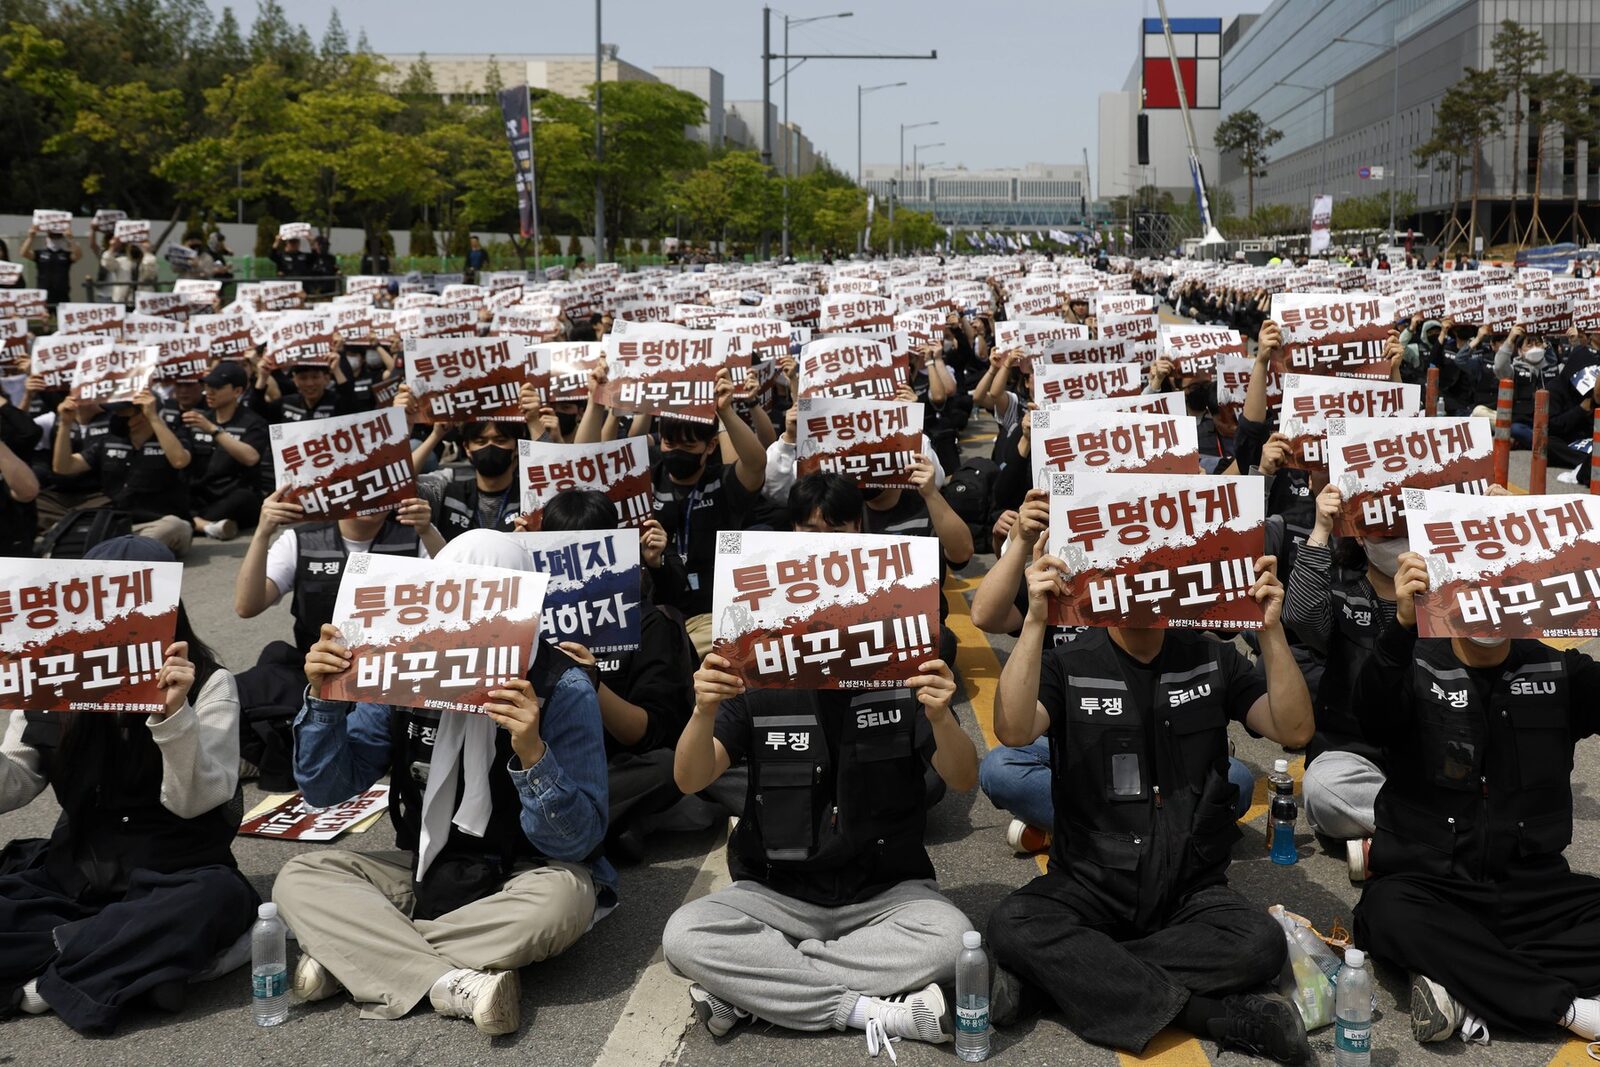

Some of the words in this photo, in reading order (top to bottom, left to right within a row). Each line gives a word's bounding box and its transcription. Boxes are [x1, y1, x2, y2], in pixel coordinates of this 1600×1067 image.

[775, 297, 821, 315] 투명하게
[828, 300, 886, 319] 투명하게
[903, 289, 946, 307] 투명하게
[1101, 298, 1147, 315] 투명하게
[1522, 301, 1568, 317] 투명하게
[64, 306, 117, 325] 투명하게
[195, 317, 244, 337] 투명하게
[424, 312, 471, 329] 투명하게
[1103, 317, 1153, 339] 투명하게
[1282, 299, 1380, 333] 투명하게
[1526, 319, 1571, 334] 바꾸고!!!
[617, 337, 713, 367] 투명하게
[1024, 327, 1081, 348] 투명하게
[1170, 331, 1232, 351] 투명하게
[414, 340, 511, 382] 투명하게
[805, 345, 882, 378] 투명하게
[431, 381, 520, 417] 바꾸고!!!
[621, 381, 714, 407] 바꾸고!!!
[1043, 366, 1129, 403] 투명하게
[1291, 387, 1404, 424] 투명하게
[807, 406, 908, 442] 투명하게
[281, 413, 392, 475] 투명하게
[1044, 420, 1179, 471] 투명하게
[1342, 422, 1474, 478] 투명하게
[527, 443, 636, 496] 투명하게
[299, 459, 412, 516] 바꾸고!!!
[1066, 482, 1240, 551] 투명하게
[1424, 499, 1594, 563] 투명하게
[308, 562, 339, 574] 투쟁
[732, 541, 913, 611] 투명하게
[1088, 556, 1257, 618] 바꾸고!!!
[350, 576, 521, 629] 투명하게
[754, 614, 932, 680] 바꾸고!!!
[356, 646, 520, 696] 바꾸고!!!
[1168, 684, 1211, 708] SELU
[1510, 678, 1556, 695] SELU
[857, 709, 901, 729] SELU
[1080, 697, 1123, 715] 투쟁
[765, 732, 810, 752] 투쟁
